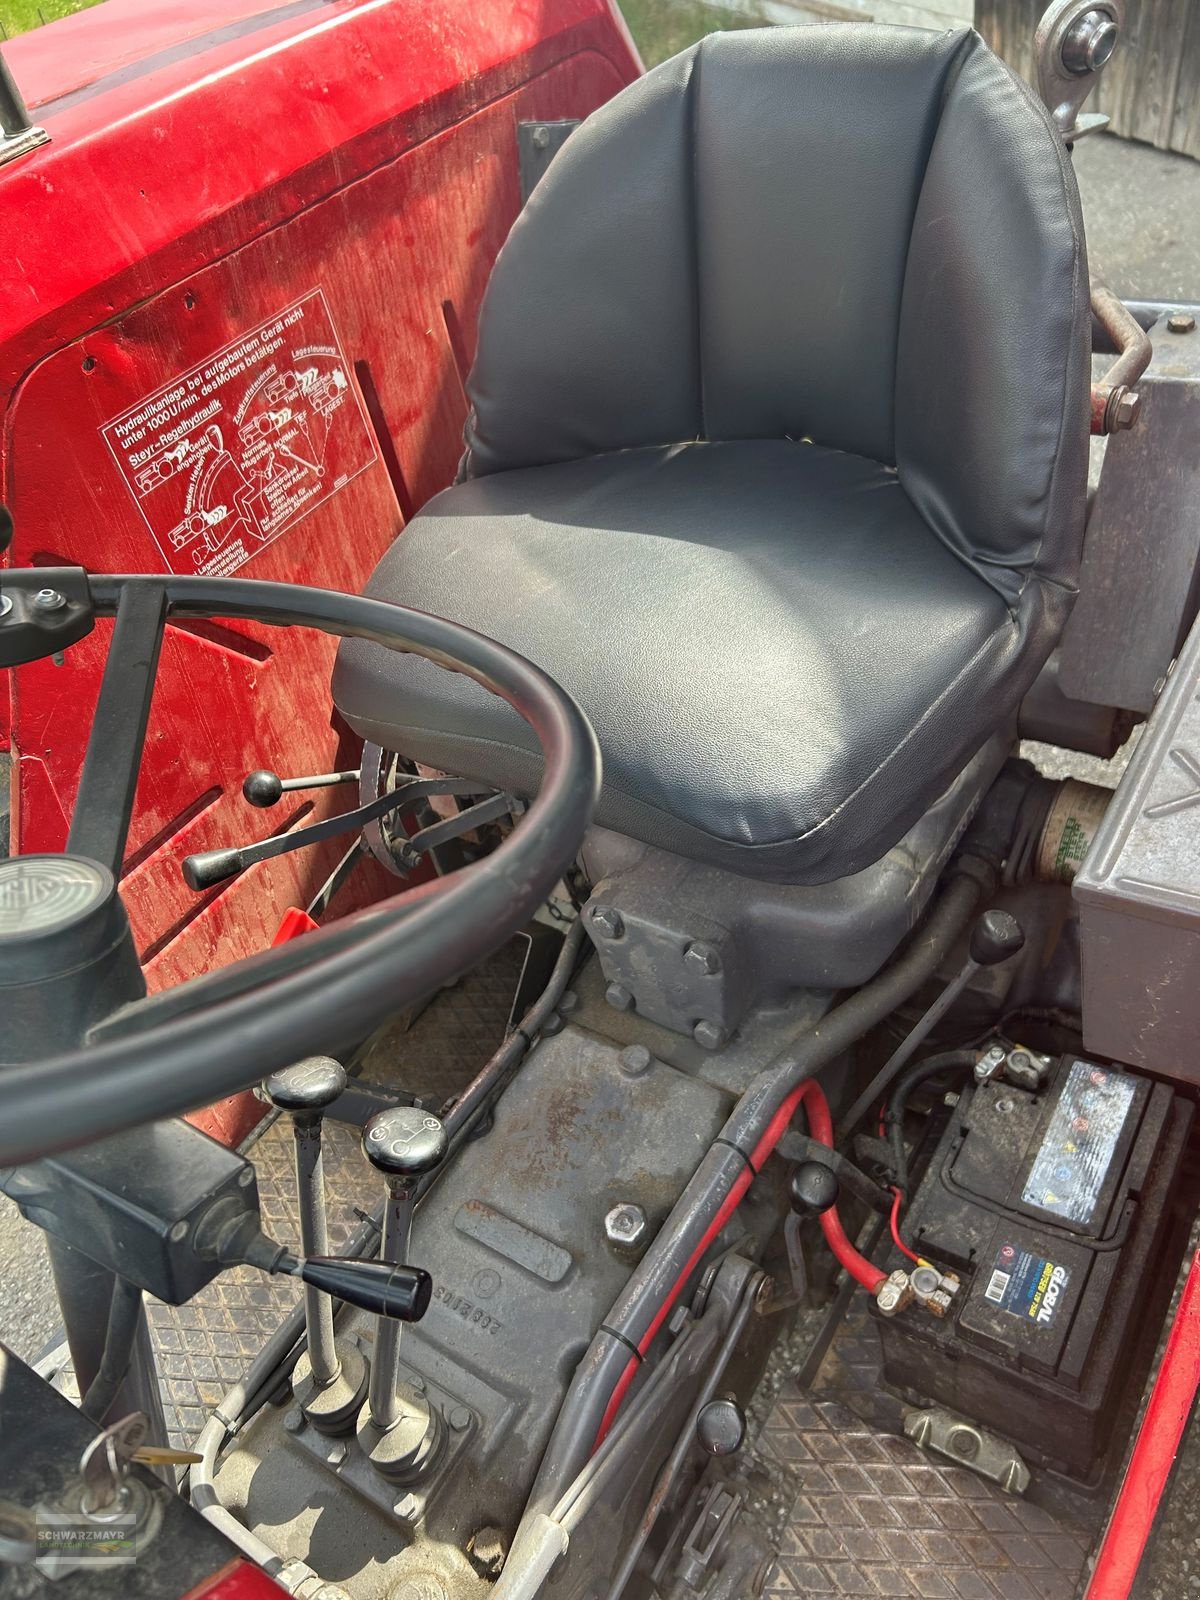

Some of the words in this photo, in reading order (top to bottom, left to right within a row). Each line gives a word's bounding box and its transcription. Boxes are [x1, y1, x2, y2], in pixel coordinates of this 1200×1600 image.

[114, 386, 186, 438] Hydraulikanlage
[187, 373, 204, 390] bei
[204, 338, 260, 379] aufgebautem
[260, 321, 284, 342] Gerät
[284, 307, 304, 327] nicht
[121, 427, 146, 449] unter
[147, 409, 171, 431] 1000
[244, 337, 286, 367] betätigen.
[241, 439, 267, 460] Normale
[273, 428, 300, 449] NORMAL
[190, 455, 206, 482] Heben
[1036, 1266, 1065, 1322] GLOBAL
